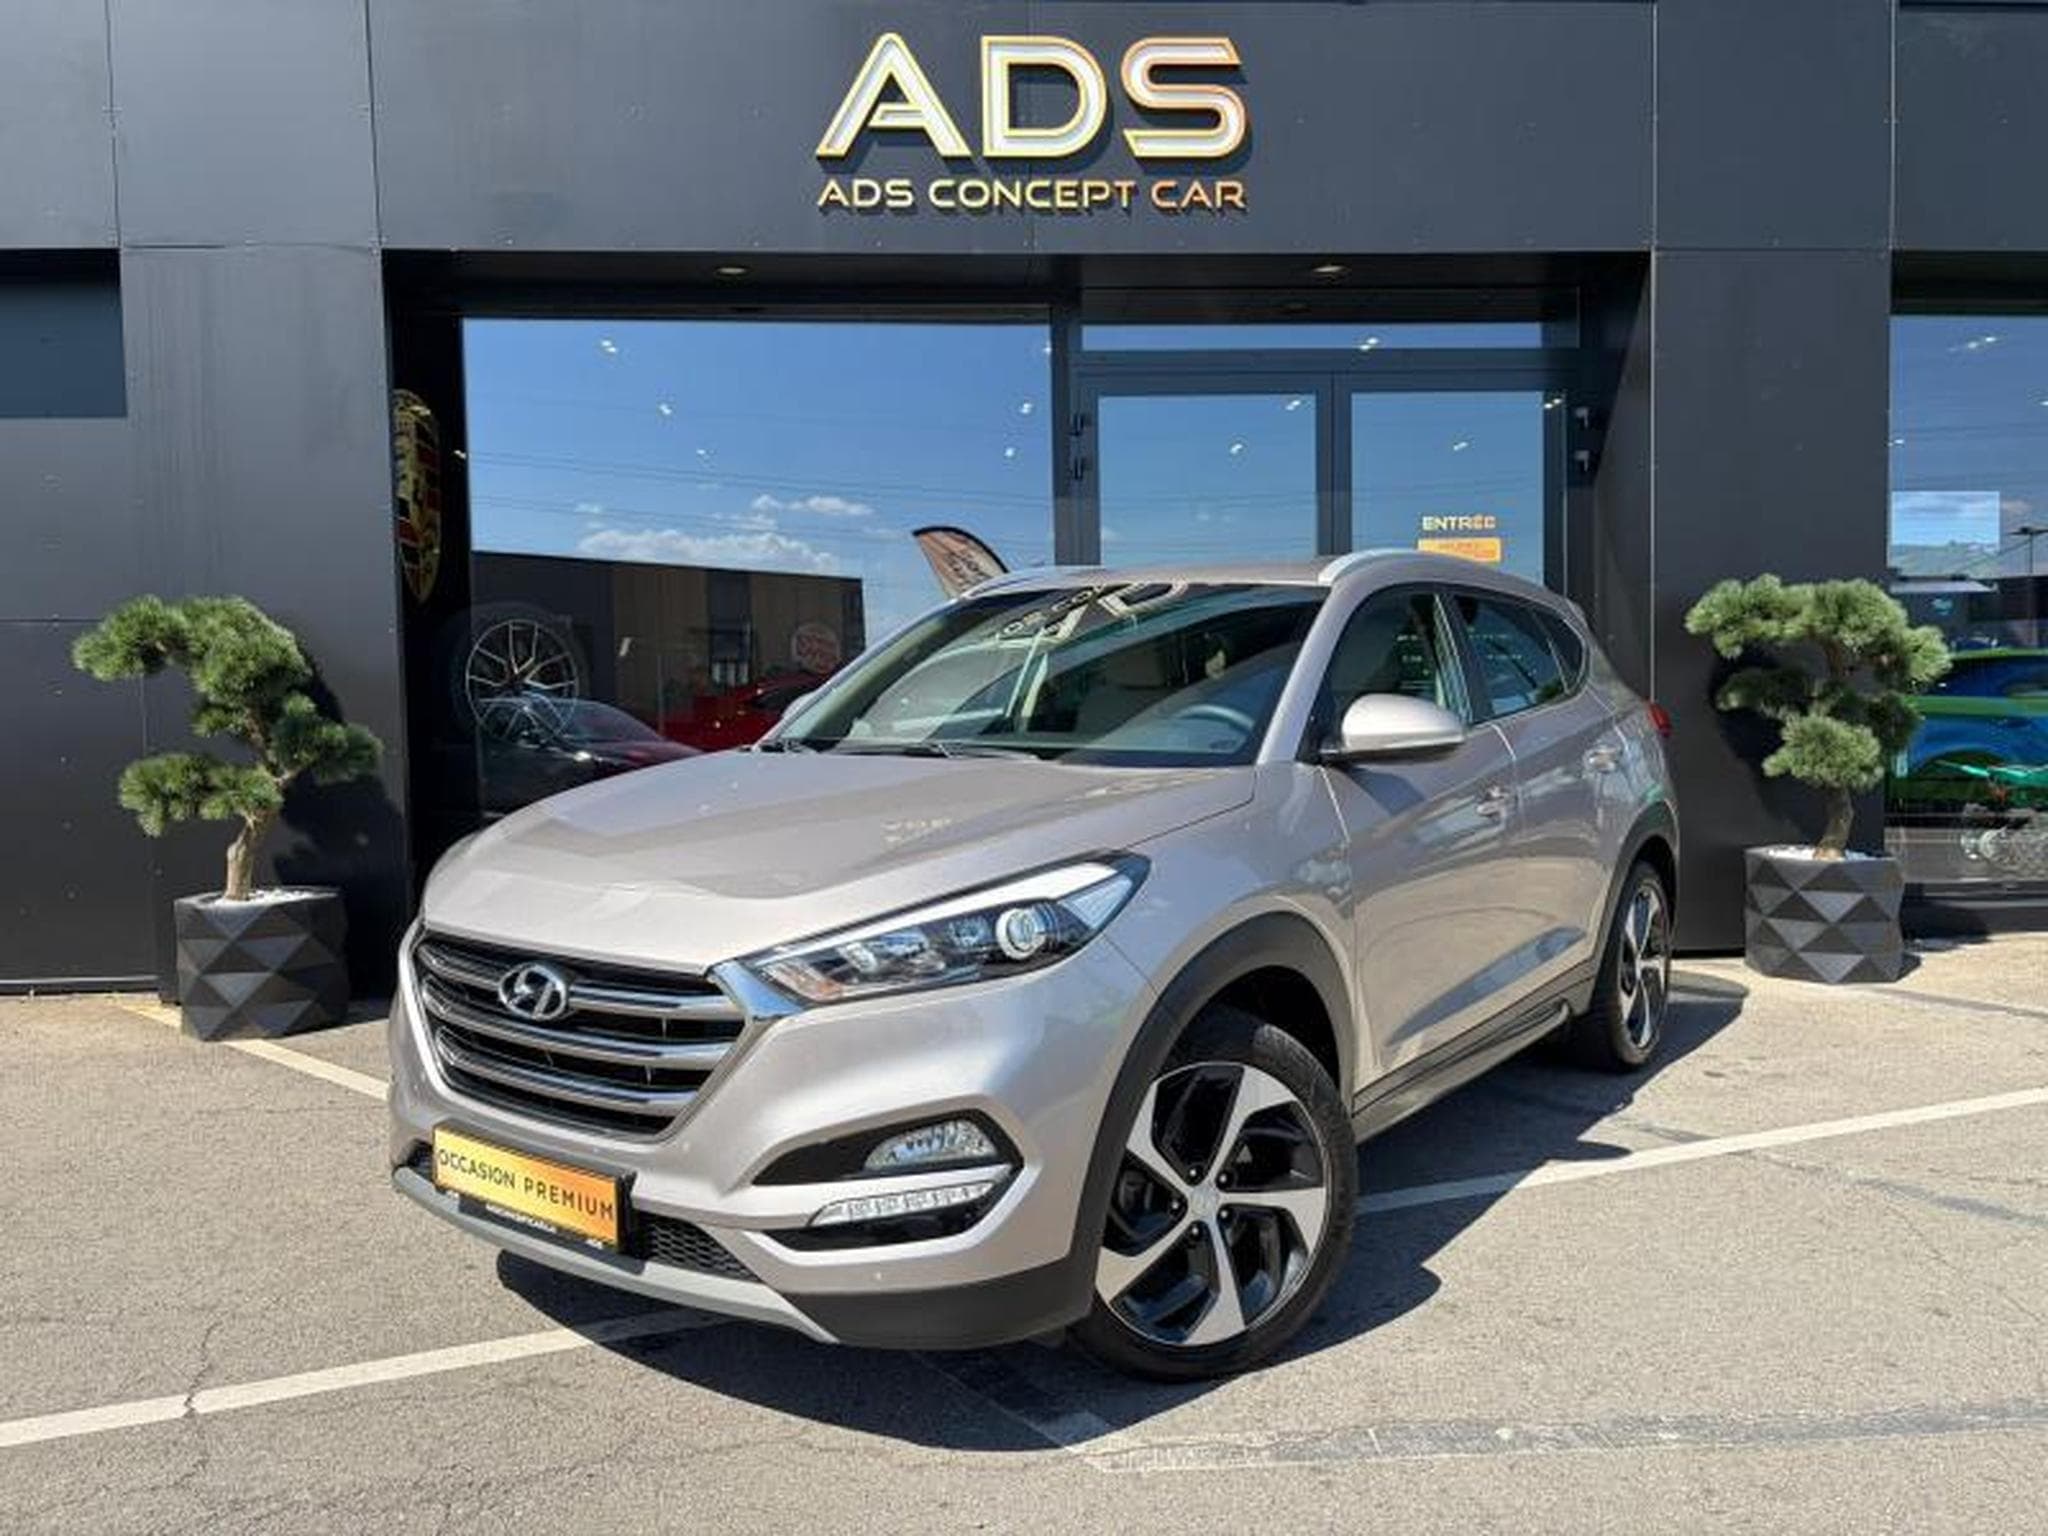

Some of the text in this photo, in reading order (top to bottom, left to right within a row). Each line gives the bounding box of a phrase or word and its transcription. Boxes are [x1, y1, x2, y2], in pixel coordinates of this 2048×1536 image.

[815, 32, 1247, 159] ADS
[816, 179, 1247, 208] ADS CONCEPT CAR
[438, 1148, 516, 1189] OCCASION
[523, 1176, 615, 1221] PREMIUM
